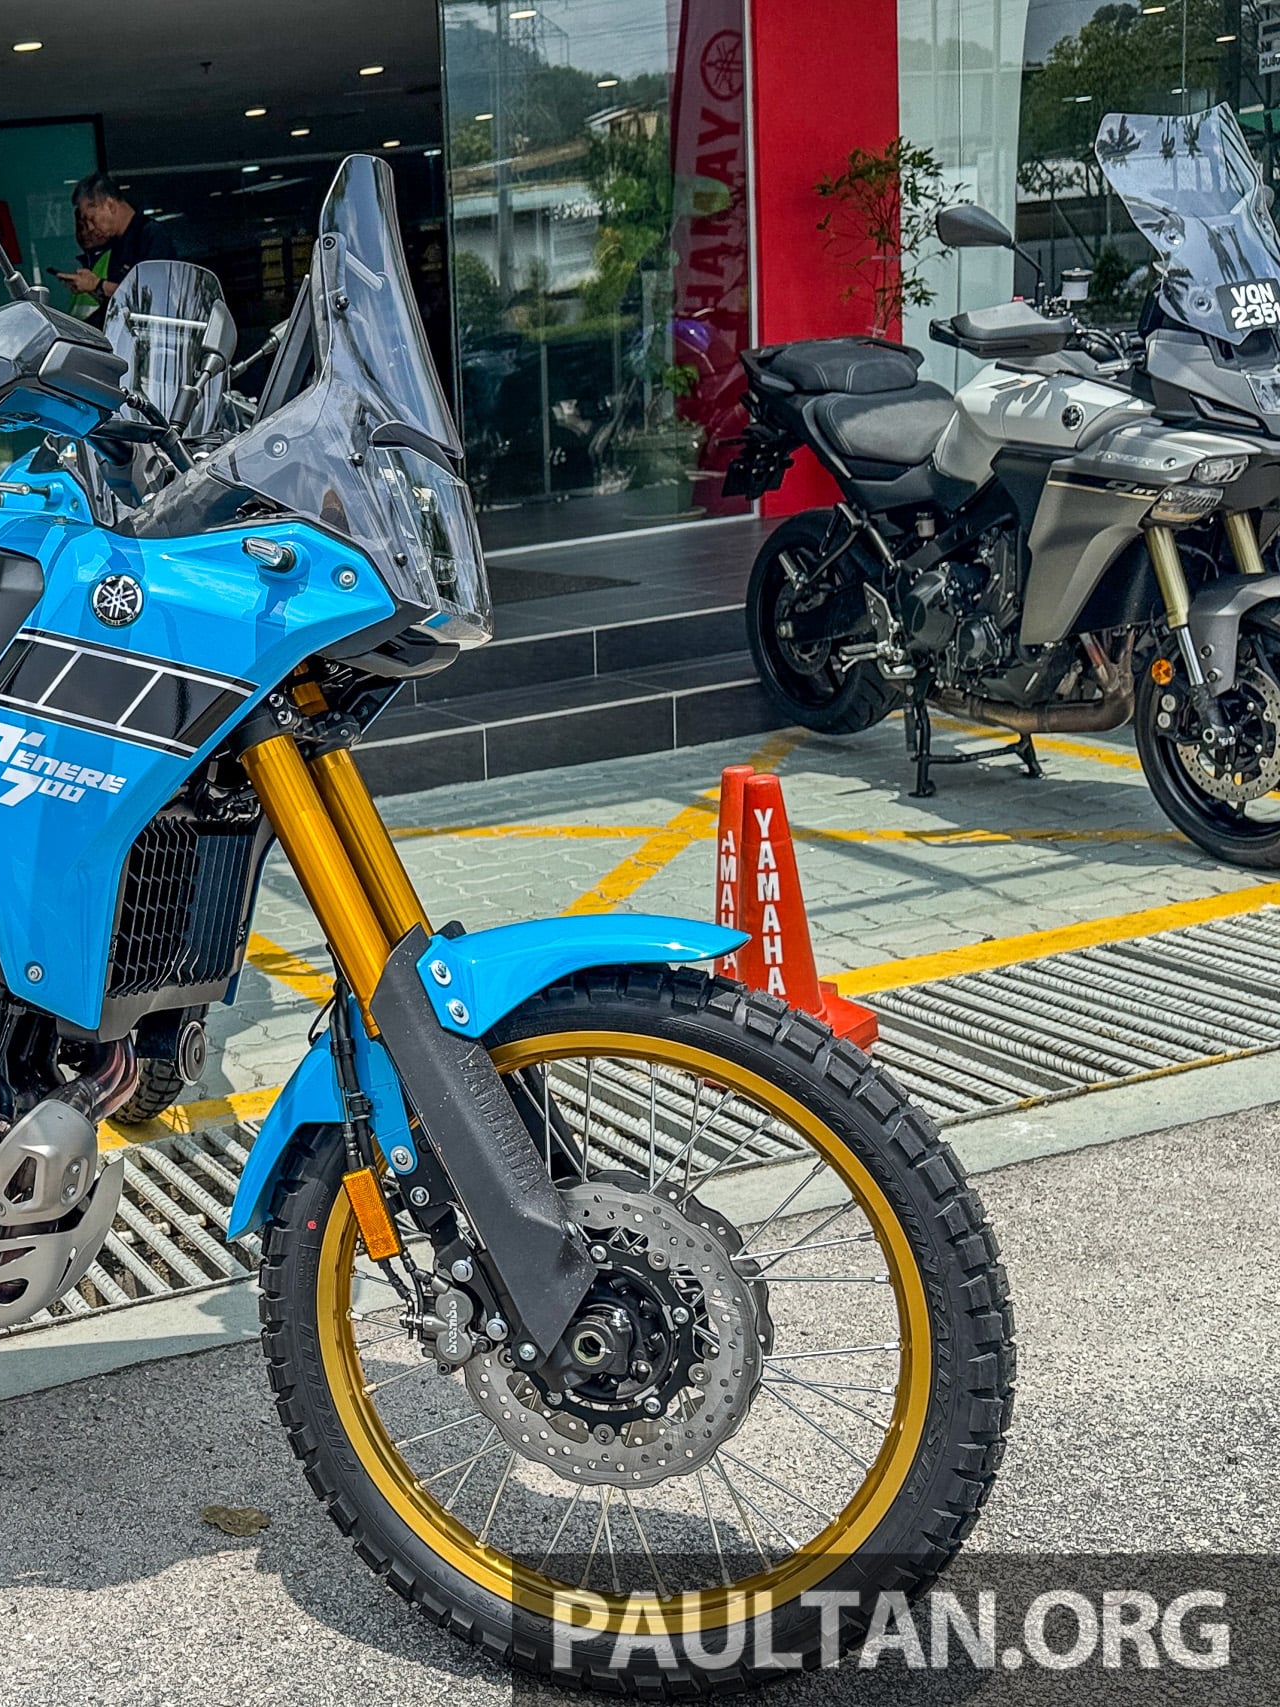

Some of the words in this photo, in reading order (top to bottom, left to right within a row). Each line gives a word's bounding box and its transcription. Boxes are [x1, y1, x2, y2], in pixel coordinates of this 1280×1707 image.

[753, 807, 787, 996] YAMAHA
[456, 1044, 546, 1194] YAMAHA
[299, 1321, 360, 1474] PIRELLI
[445, 1299, 458, 1354] brembo
